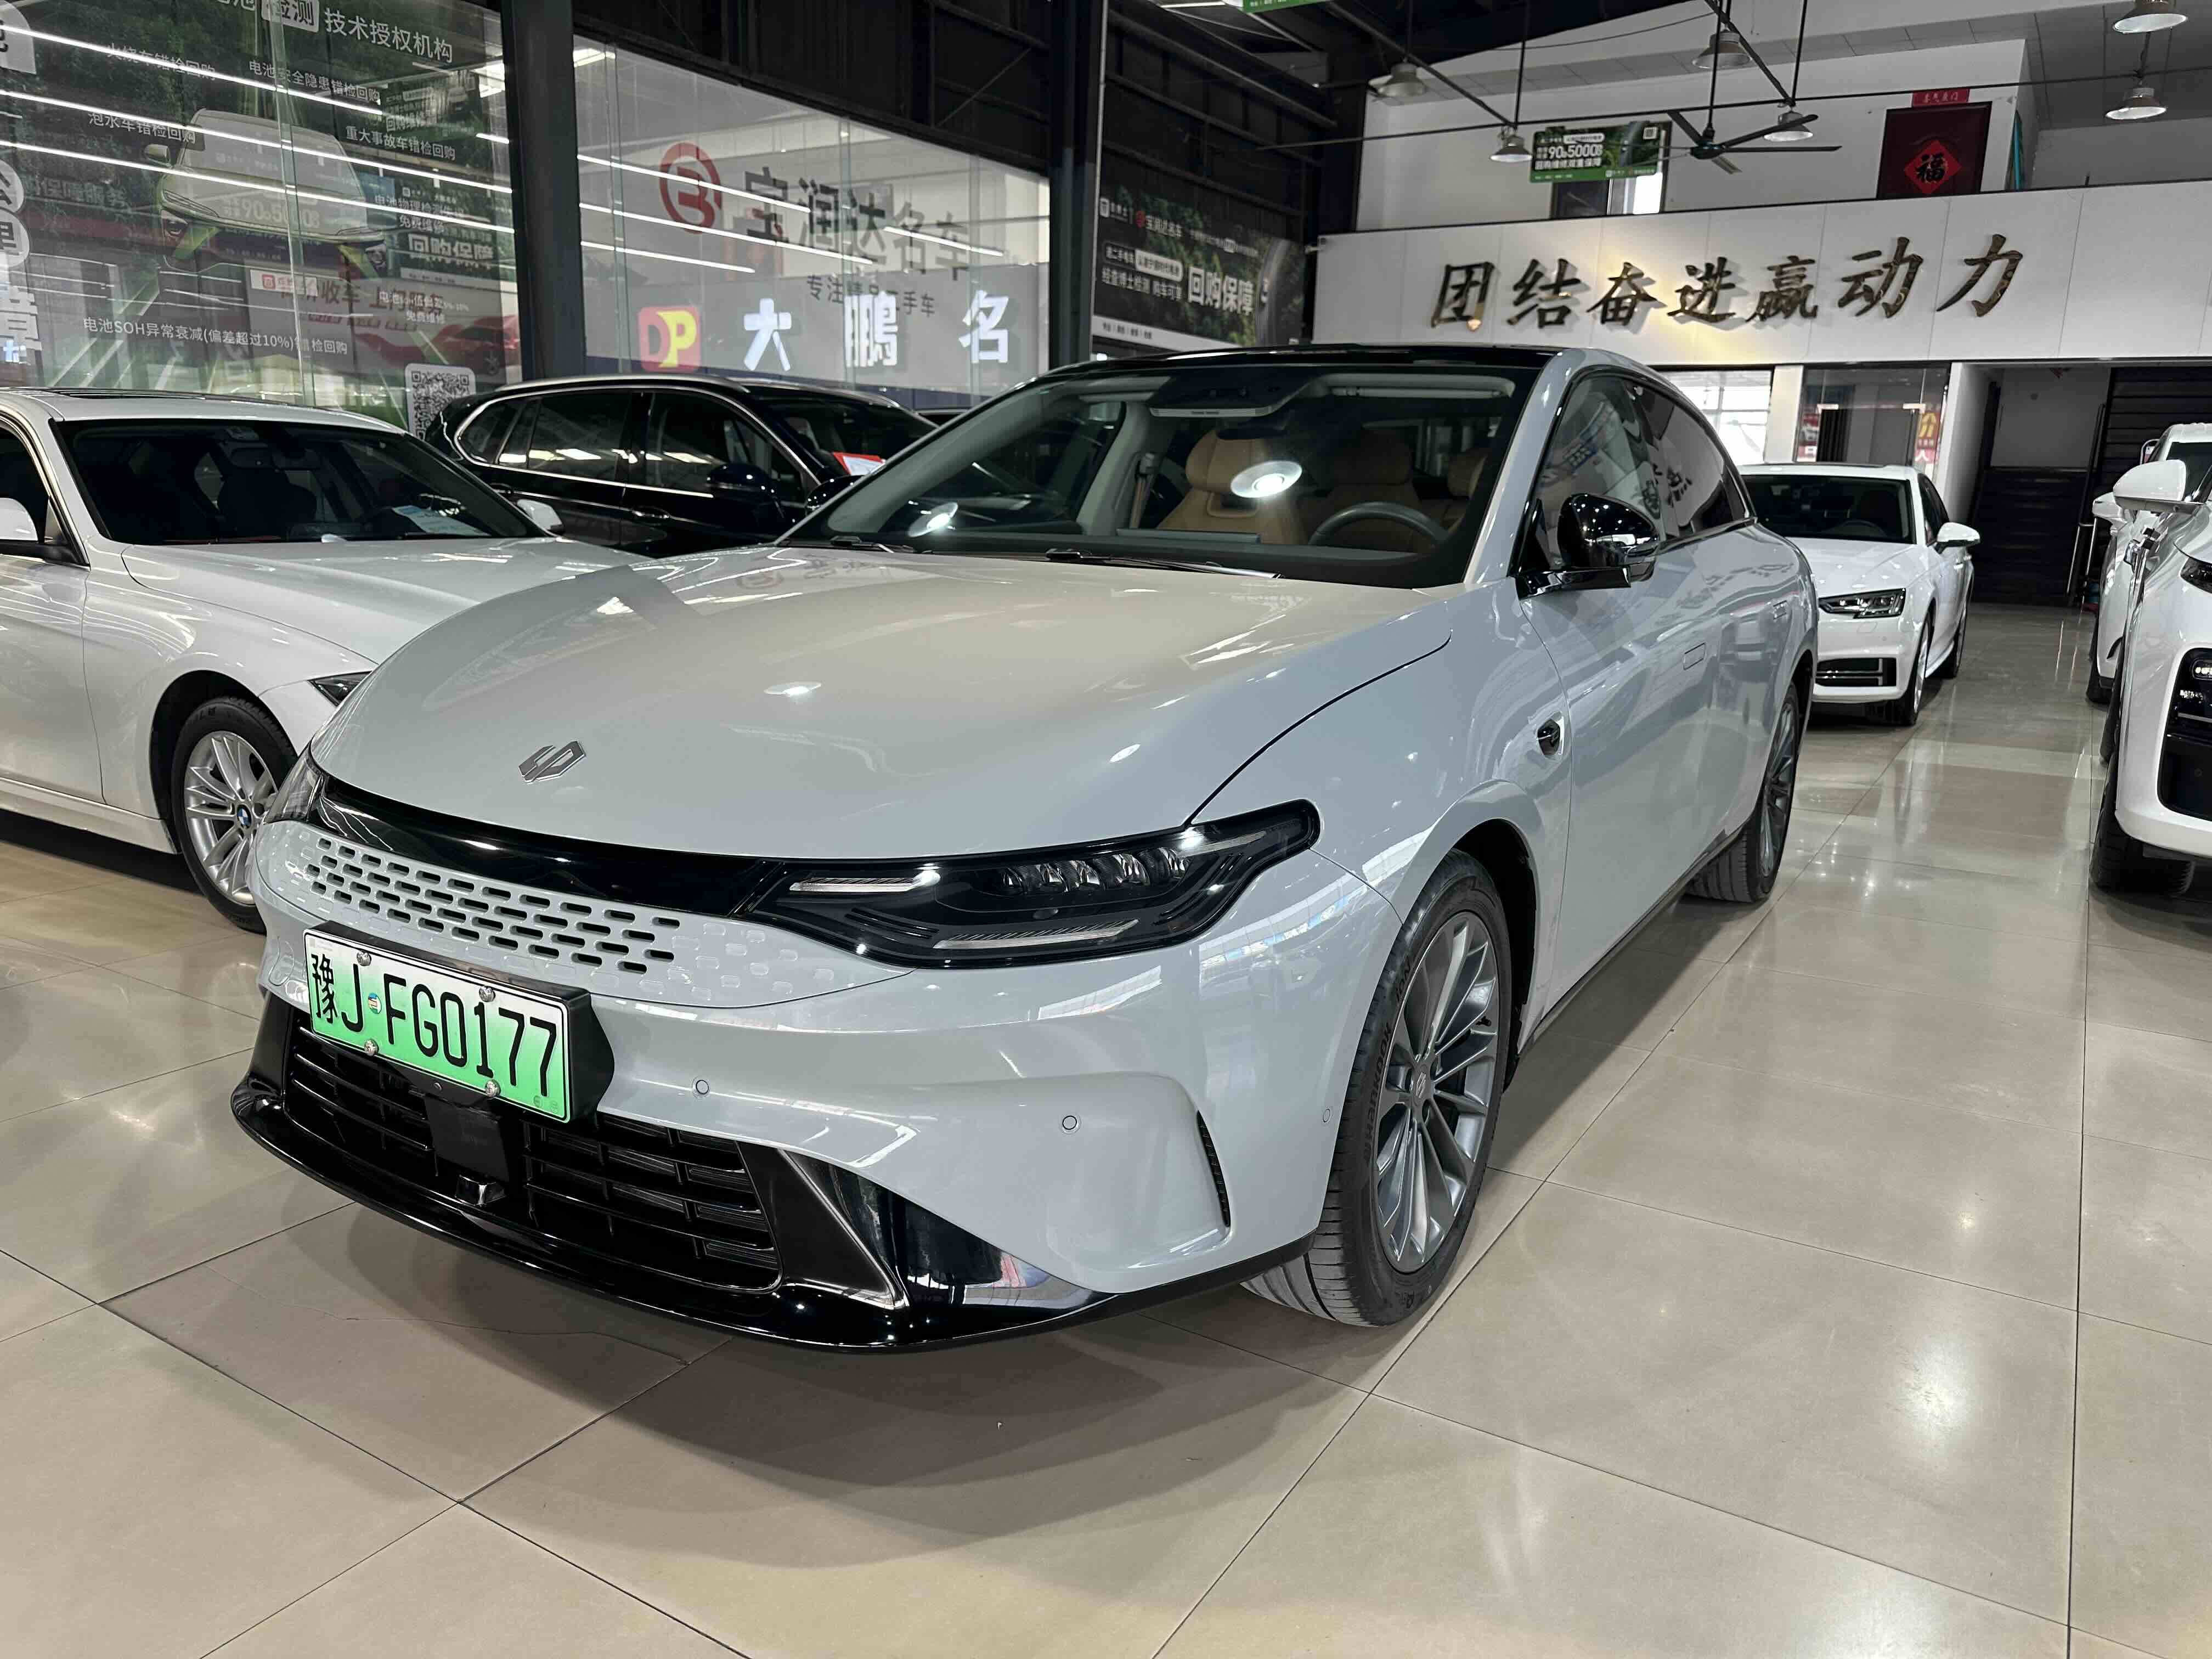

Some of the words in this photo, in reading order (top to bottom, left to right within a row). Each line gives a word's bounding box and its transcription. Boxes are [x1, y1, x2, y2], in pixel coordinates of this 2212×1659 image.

[325, 8, 453, 63] 技术授权机构
[250, 60, 381, 102] 电池安全隐患错检回购
[88, 112, 196, 144] 泡水车错检回购
[345, 126, 456, 161] 重大事故车错检回购
[1915, 153, 1946, 182] 福
[1188, 266, 1254, 316] 回购保障
[1431, 234, 2023, 330] 团结奋进赢动力
